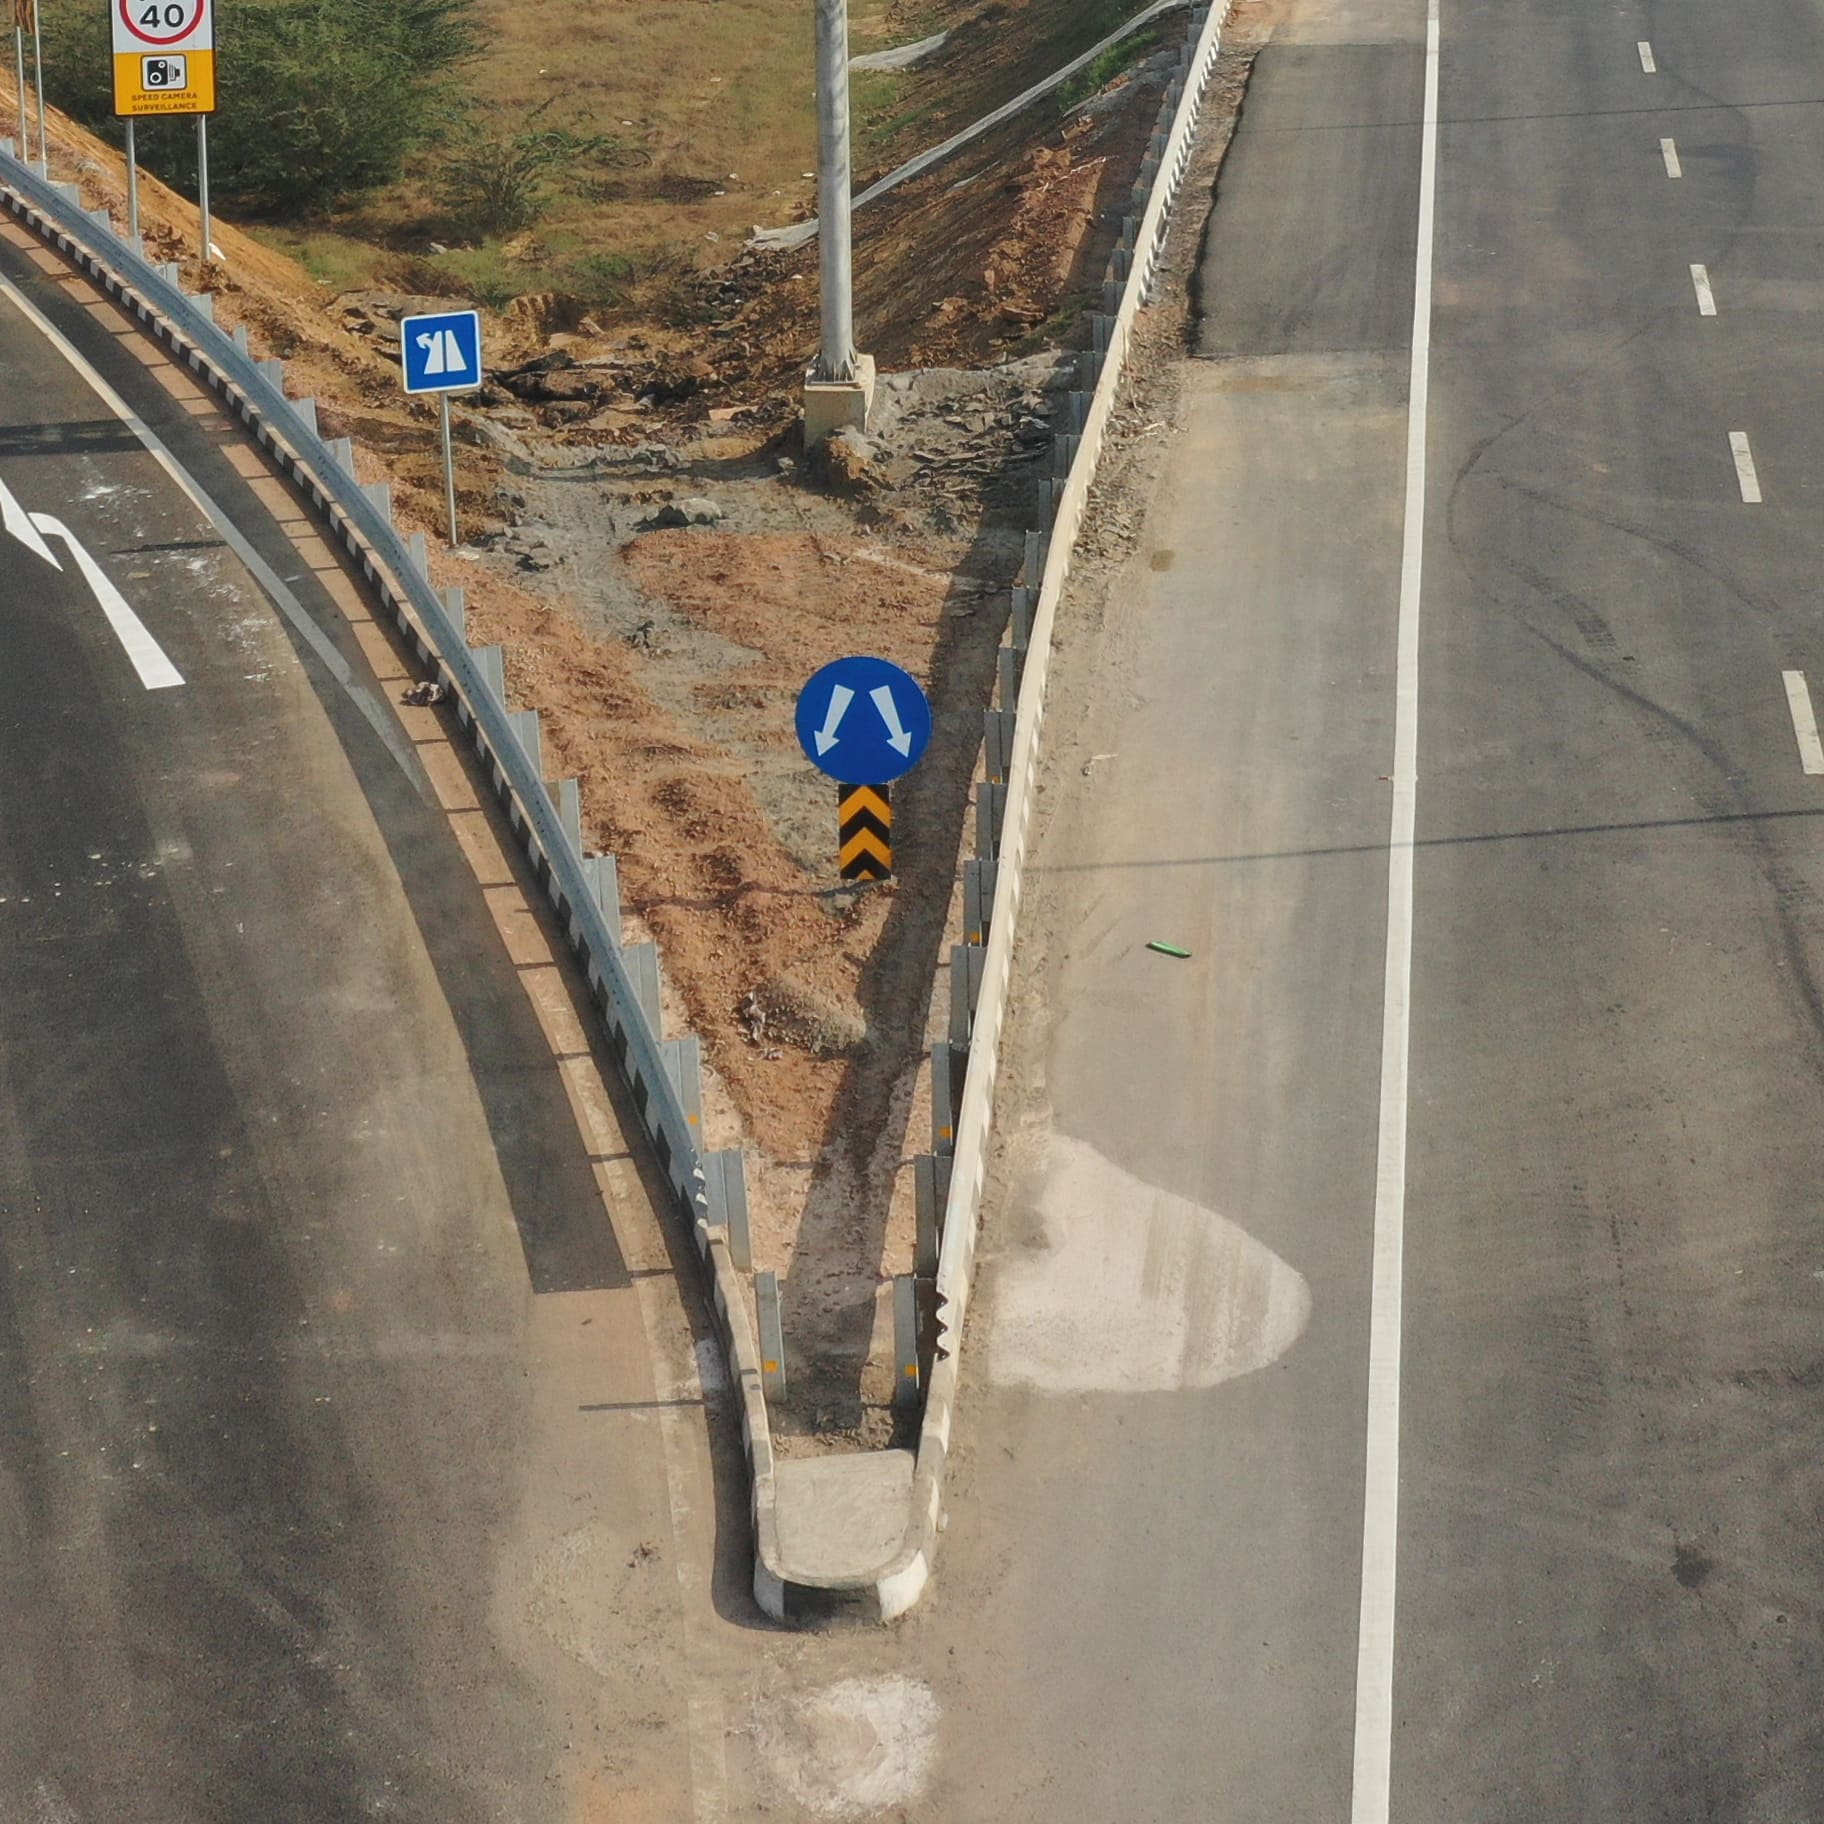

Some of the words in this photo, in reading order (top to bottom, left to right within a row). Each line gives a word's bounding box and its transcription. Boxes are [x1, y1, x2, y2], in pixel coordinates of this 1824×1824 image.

[139, 4, 185, 28] 40
[131, 93, 160, 102] SPEED
[161, 92, 198, 101] CAMERA
[131, 102, 198, 112] SURVEILLANCE
